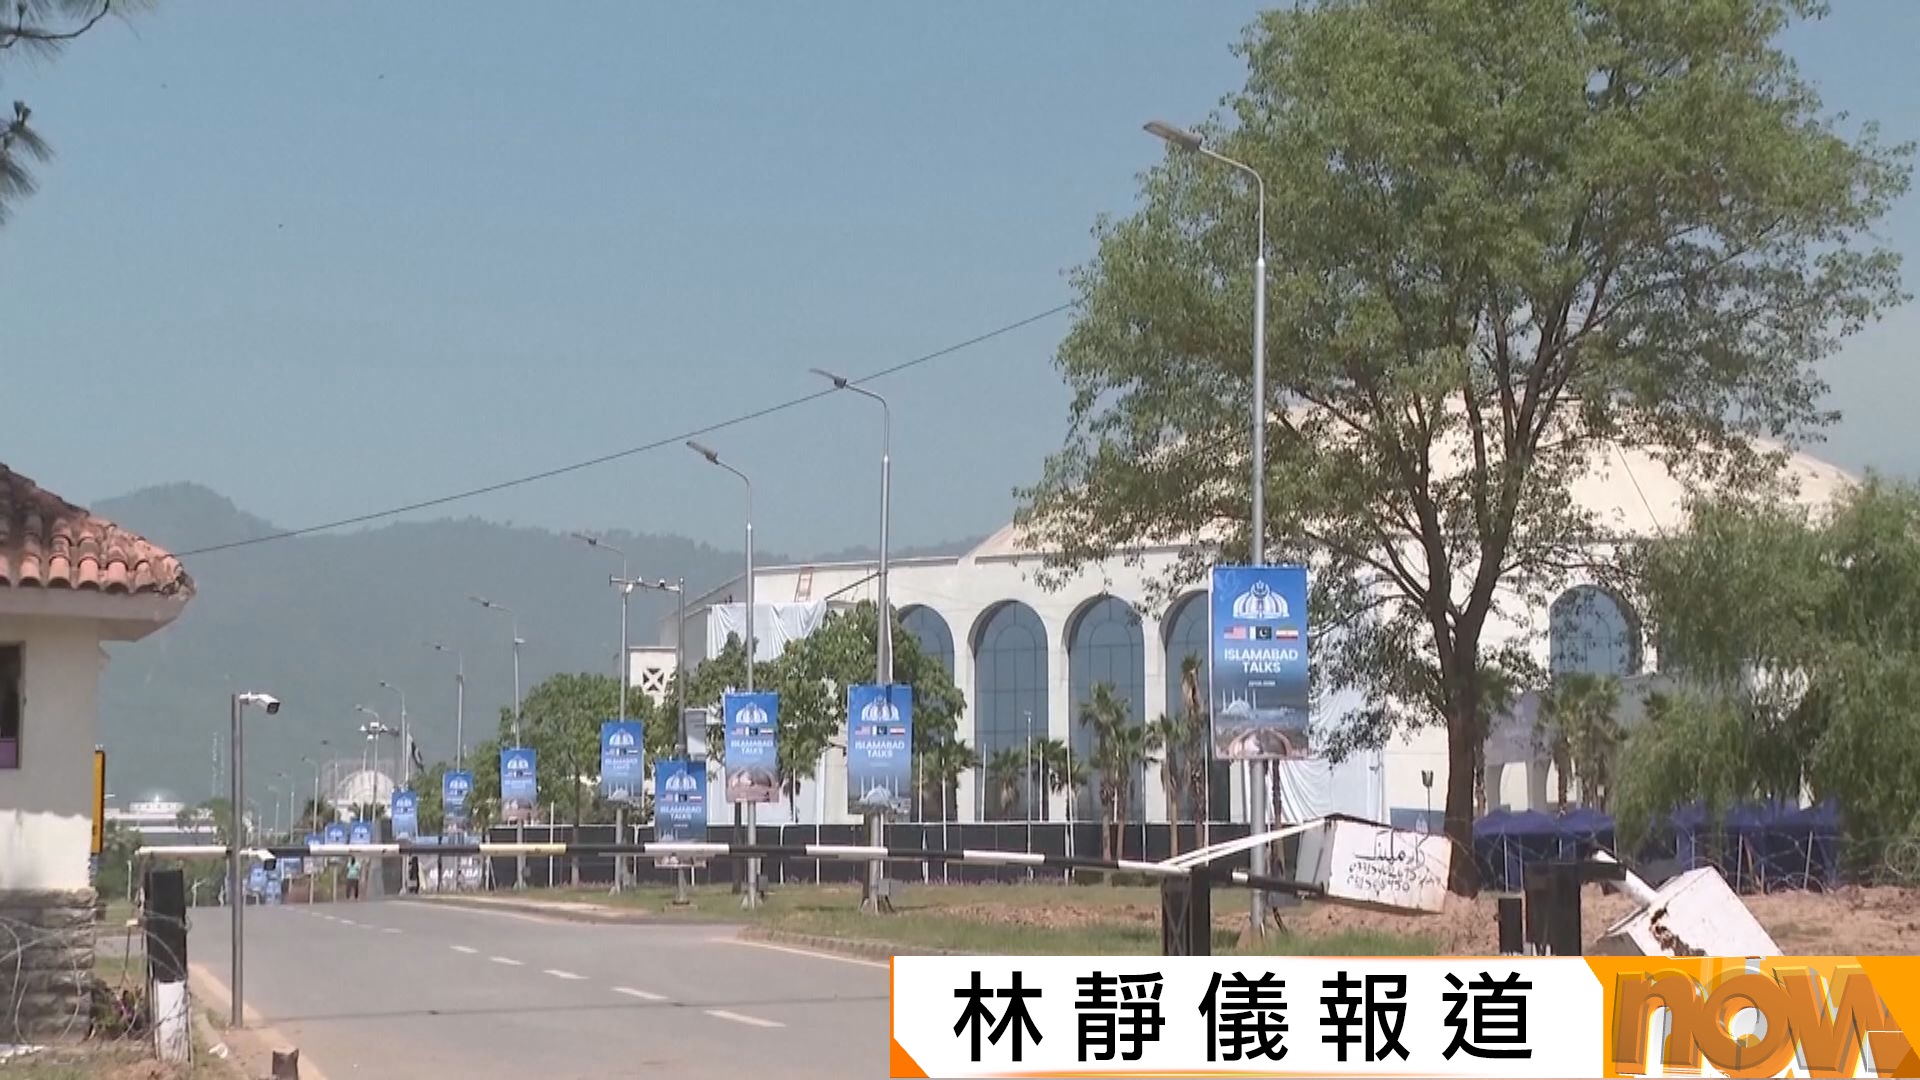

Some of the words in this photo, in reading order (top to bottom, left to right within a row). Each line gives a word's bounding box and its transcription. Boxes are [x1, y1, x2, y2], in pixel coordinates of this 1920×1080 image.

[1224, 649, 1298, 662] ISLAMABAD
[1242, 661, 1281, 674] TALKS
[855, 740, 905, 750] ISLAMABAD
[867, 749, 893, 758] TALKS
